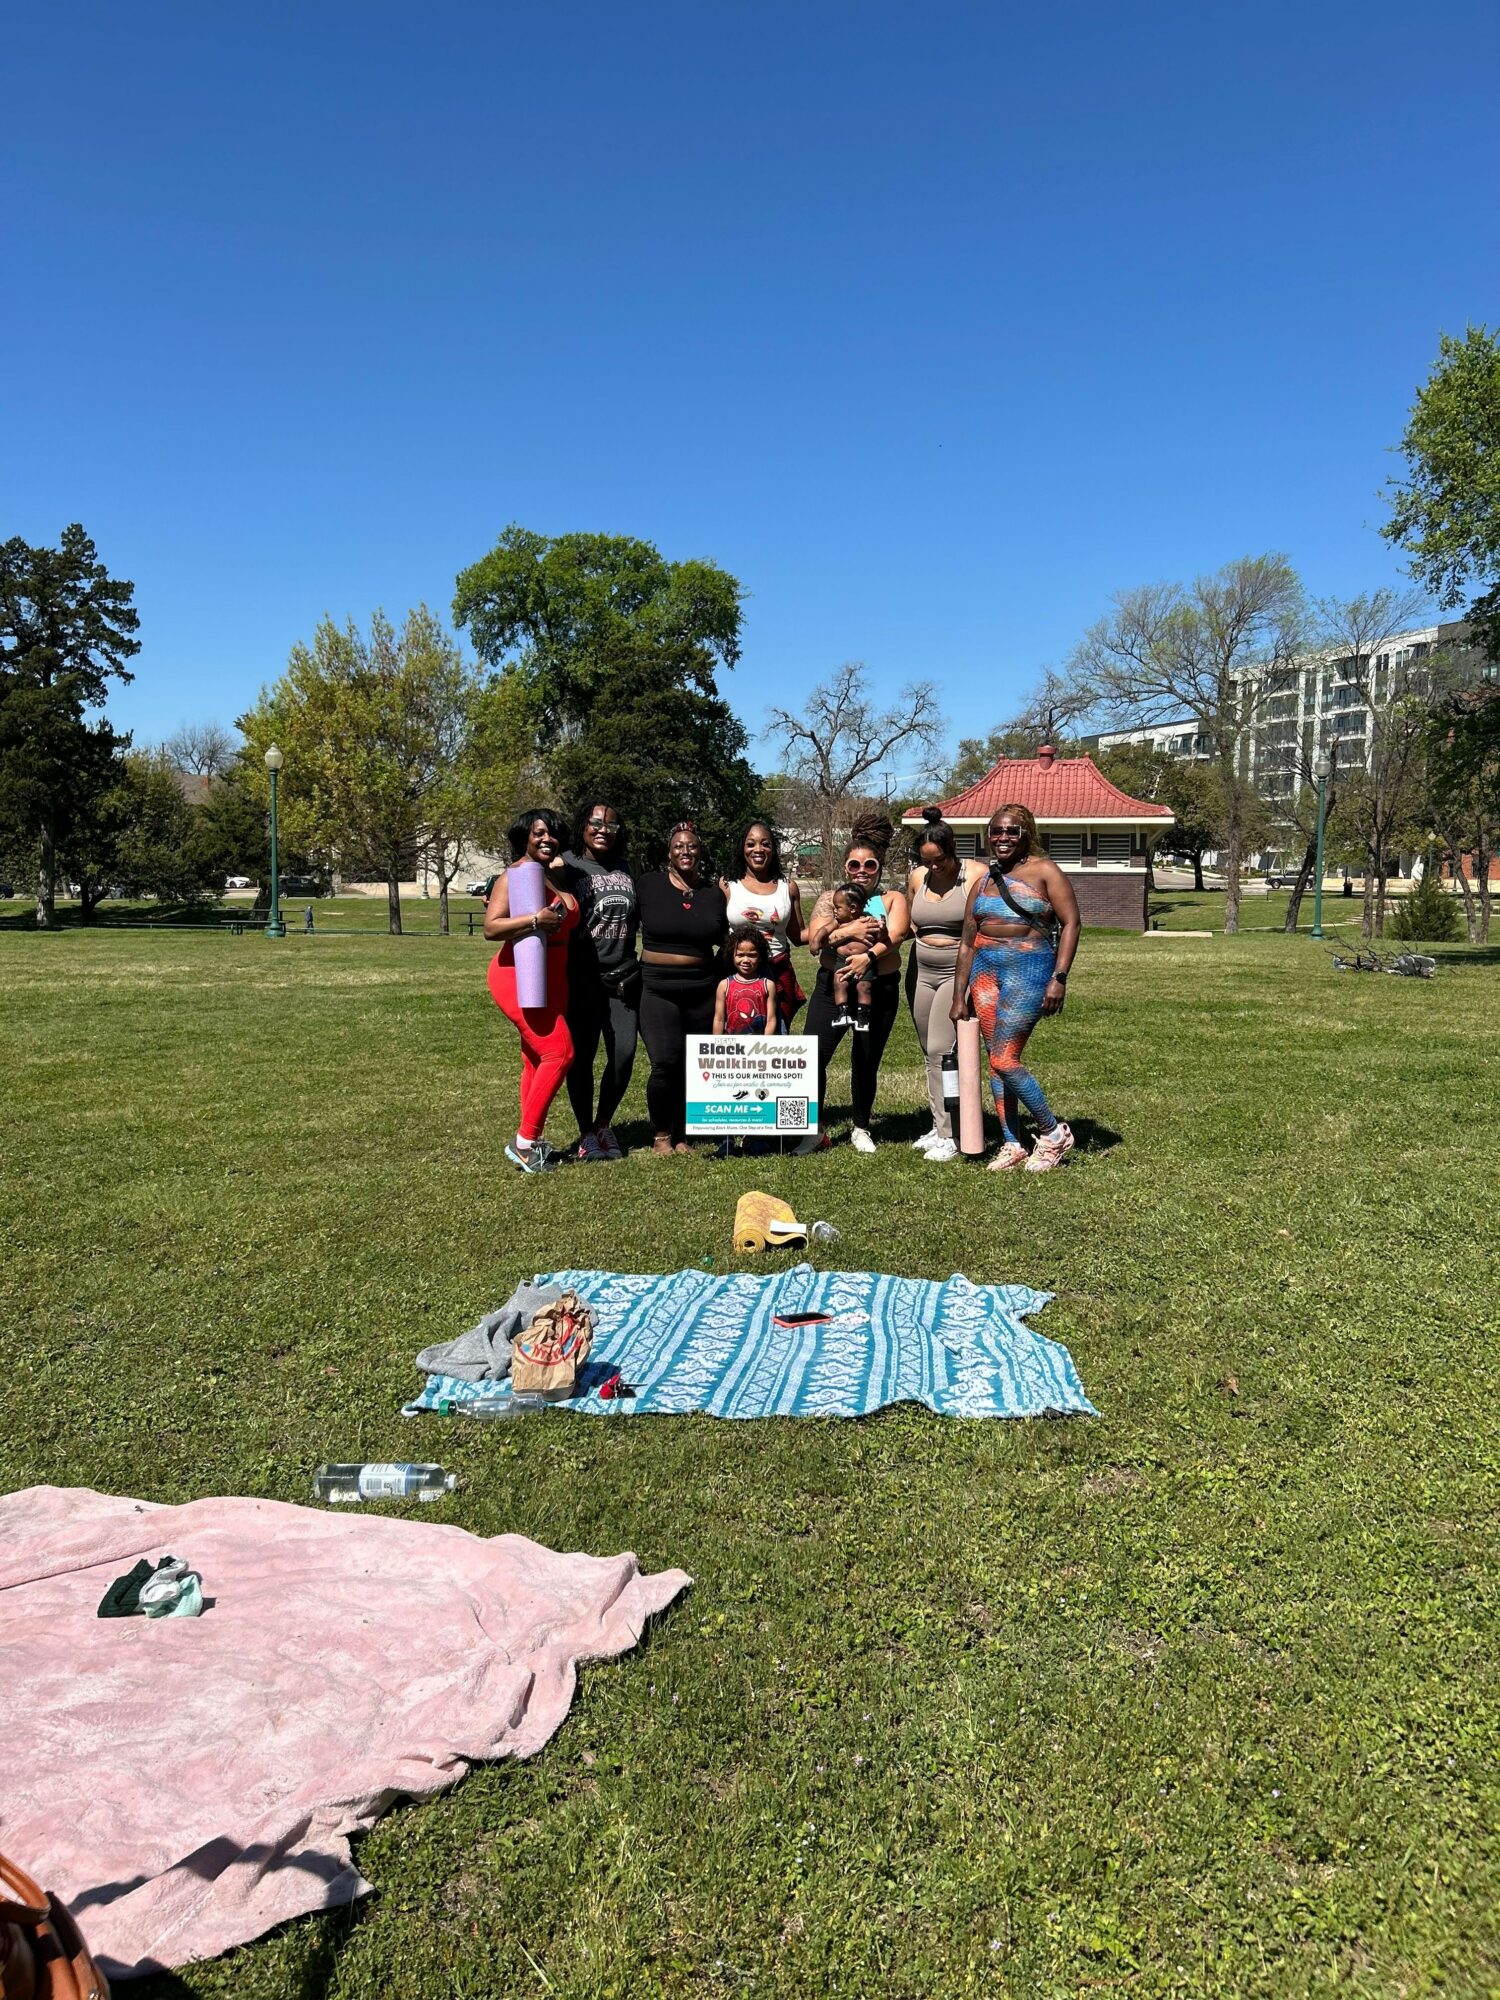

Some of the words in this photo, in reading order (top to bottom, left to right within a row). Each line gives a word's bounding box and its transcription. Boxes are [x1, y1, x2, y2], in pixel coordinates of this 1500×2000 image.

[699, 1043, 745, 1055] Black
[747, 1041, 807, 1056] Moms
[698, 1058, 767, 1072] Walking
[771, 1058, 807, 1069] Club
[704, 1105, 731, 1113] SCAN
[733, 1105, 749, 1113] ME
